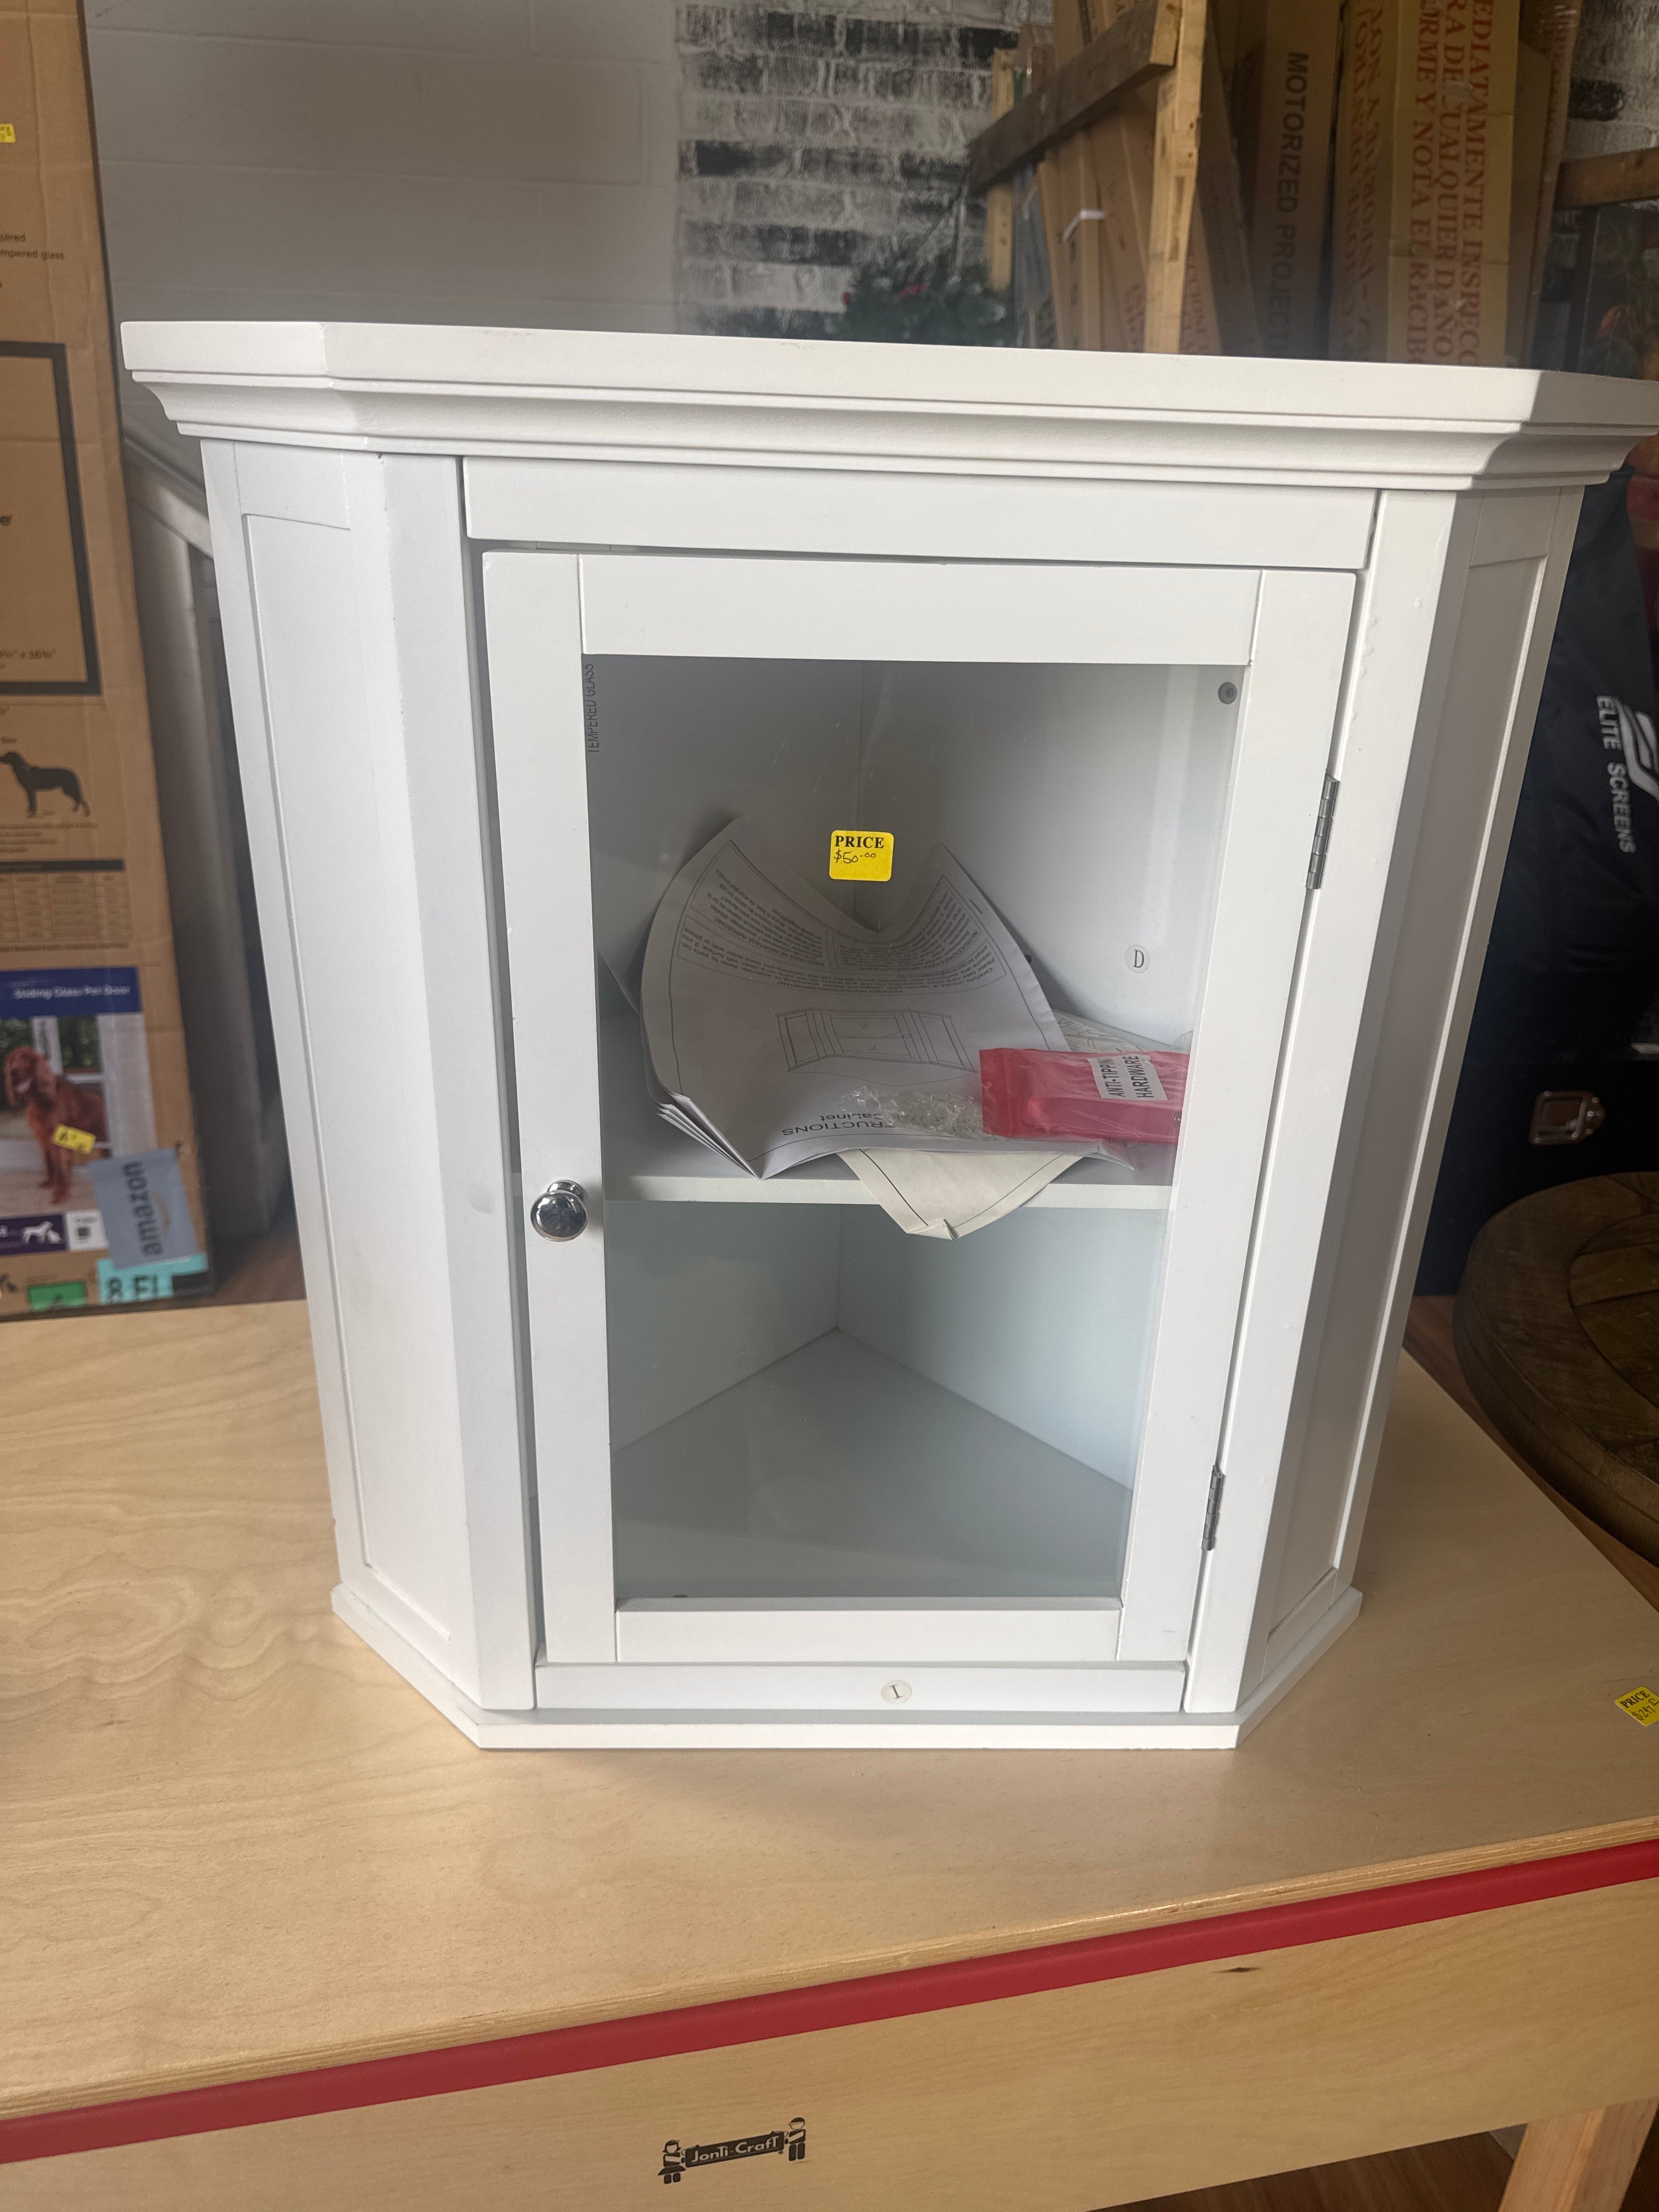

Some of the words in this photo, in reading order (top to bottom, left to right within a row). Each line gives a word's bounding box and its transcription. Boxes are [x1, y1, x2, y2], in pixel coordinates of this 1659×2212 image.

[1442, 44, 1465, 83] DE
[1415, 89, 1436, 111] Y
[1276, 52, 1309, 213] MOTORIZED
[1411, 119, 1434, 209] NOTA
[1595, 695, 1622, 751] ELITE
[1607, 761, 1637, 854] SCREENS
[834, 835, 884, 849] PRICE
[682, 934, 693, 944] you
[693, 949, 709, 958] parts
[973, 951, 991, 968] require
[974, 946, 988, 960] email
[1133, 950, 1144, 968] D
[977, 957, 995, 972] Please
[963, 970, 976, 979] take
[967, 968, 993, 983] Carefully
[13, 988, 53, 1000] Sliding
[103, 984, 131, 996] Door
[1122, 1056, 1154, 1098] HARDWARE
[819, 1113, 884, 1122] Cabinet
[121, 1161, 163, 1257] amazon
[1620, 1690, 1651, 1708] PRICE
